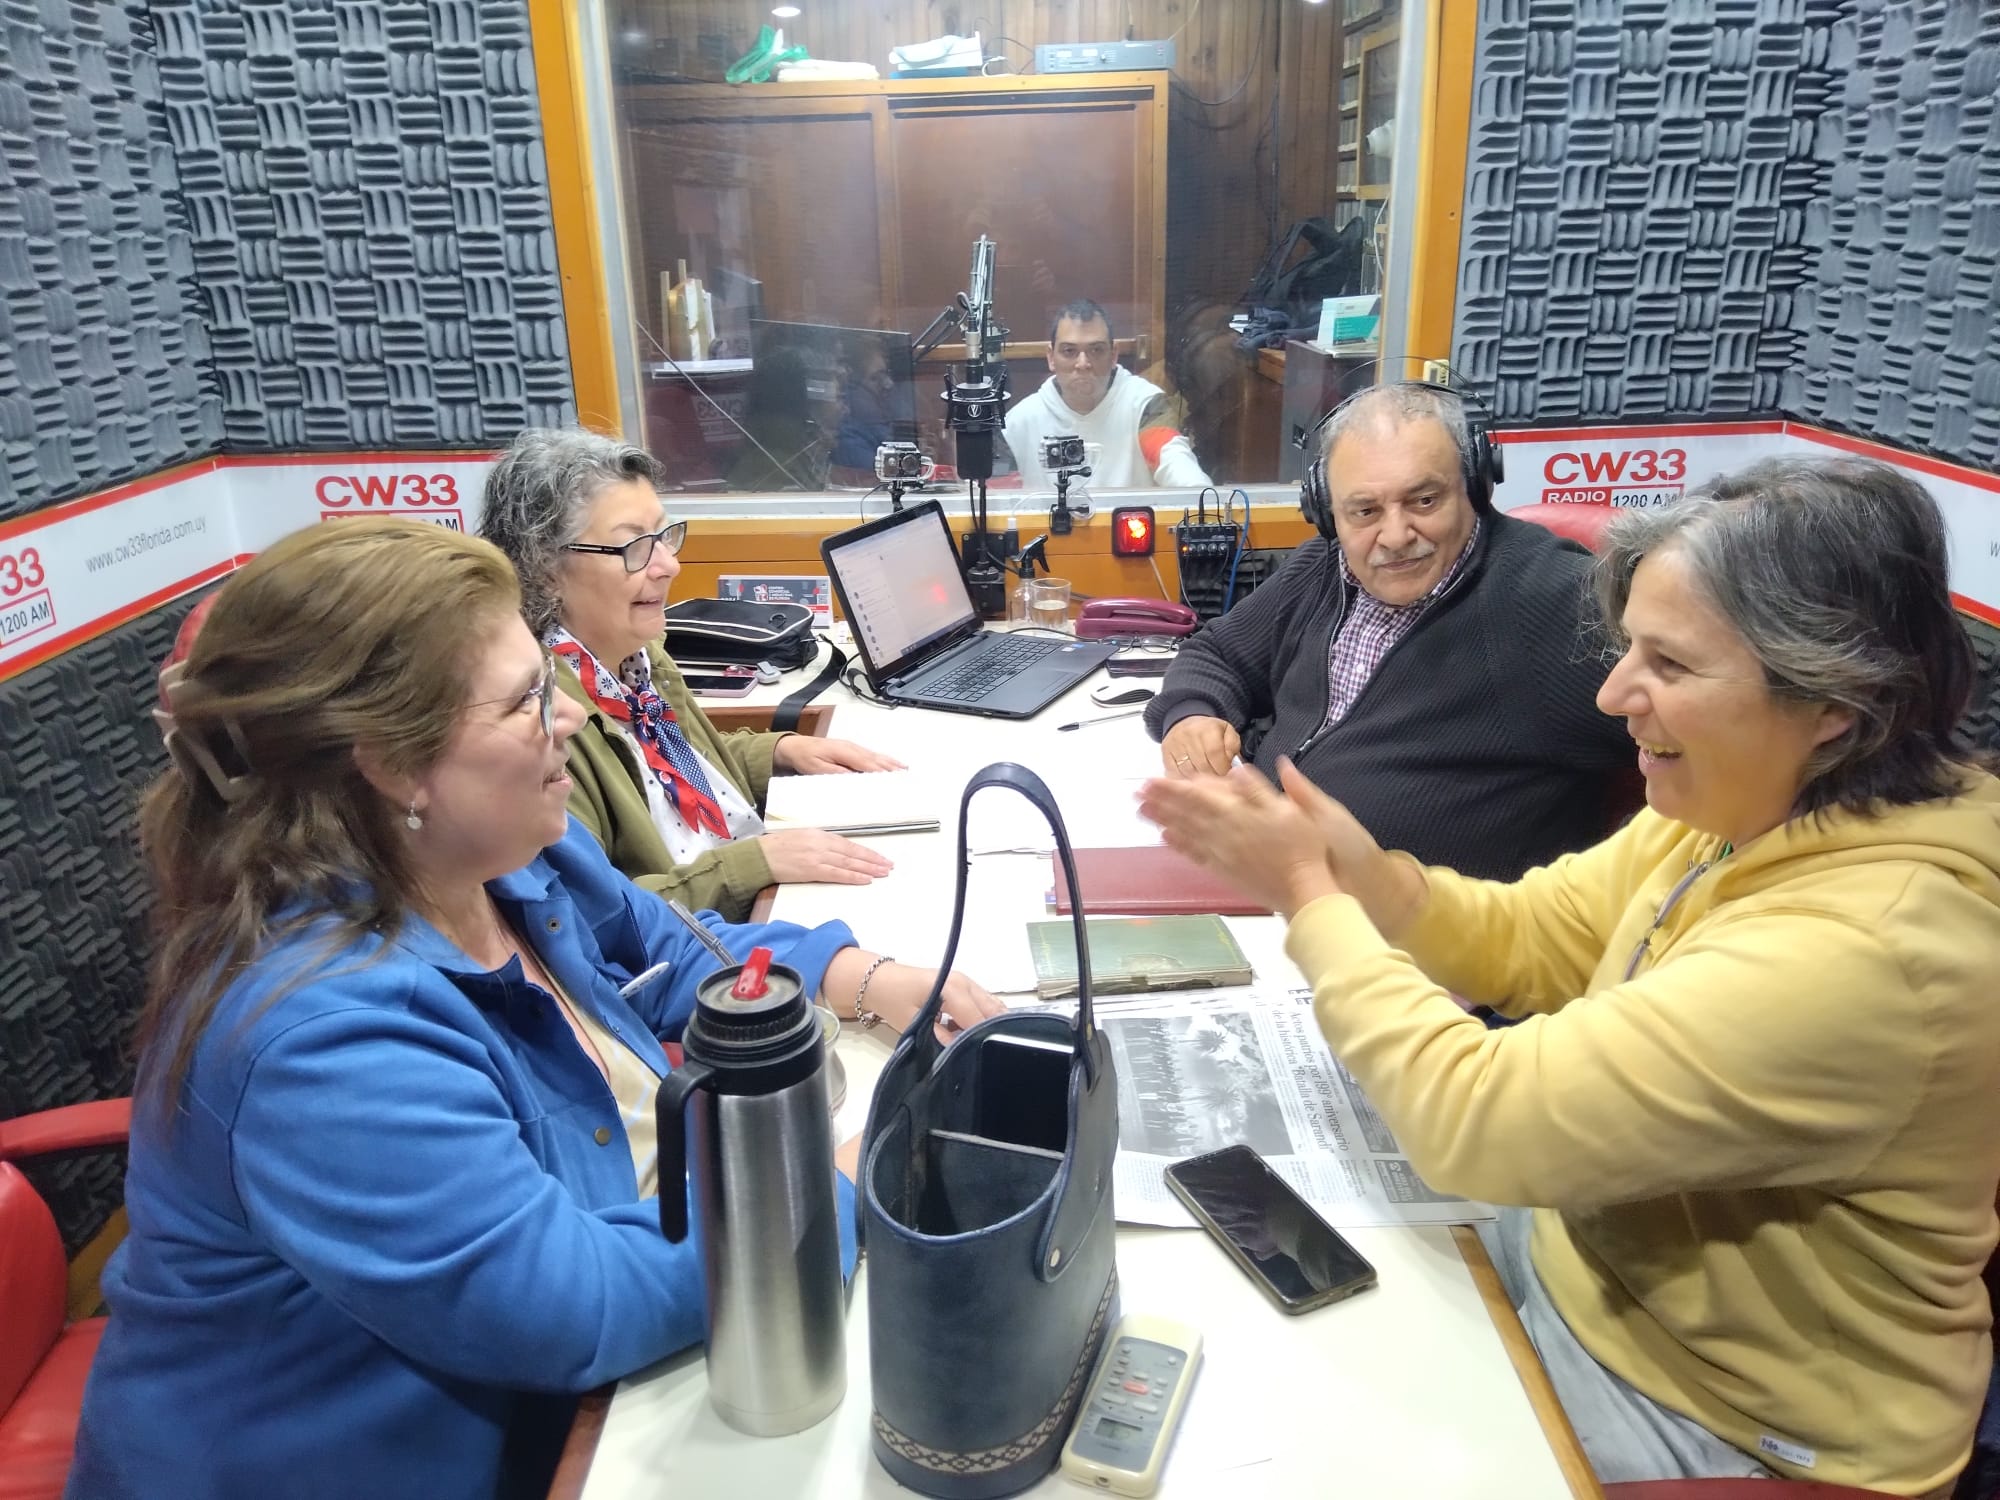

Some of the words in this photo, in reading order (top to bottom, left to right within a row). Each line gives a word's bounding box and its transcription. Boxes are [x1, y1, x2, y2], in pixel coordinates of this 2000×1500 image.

[1544, 449, 1687, 485] CW33
[315, 474, 459, 508] CW33
[1547, 491, 1606, 503] RADIO
[1613, 494, 1648, 508] 1200
[0, 611, 28, 637] 1200
[31, 600, 51, 625] AM
[1278, 1030, 1299, 1065] histórica
[1302, 1099, 1318, 1112] de
[1303, 1064, 1322, 1081] por
[1321, 1100, 1351, 1152] aniversario
